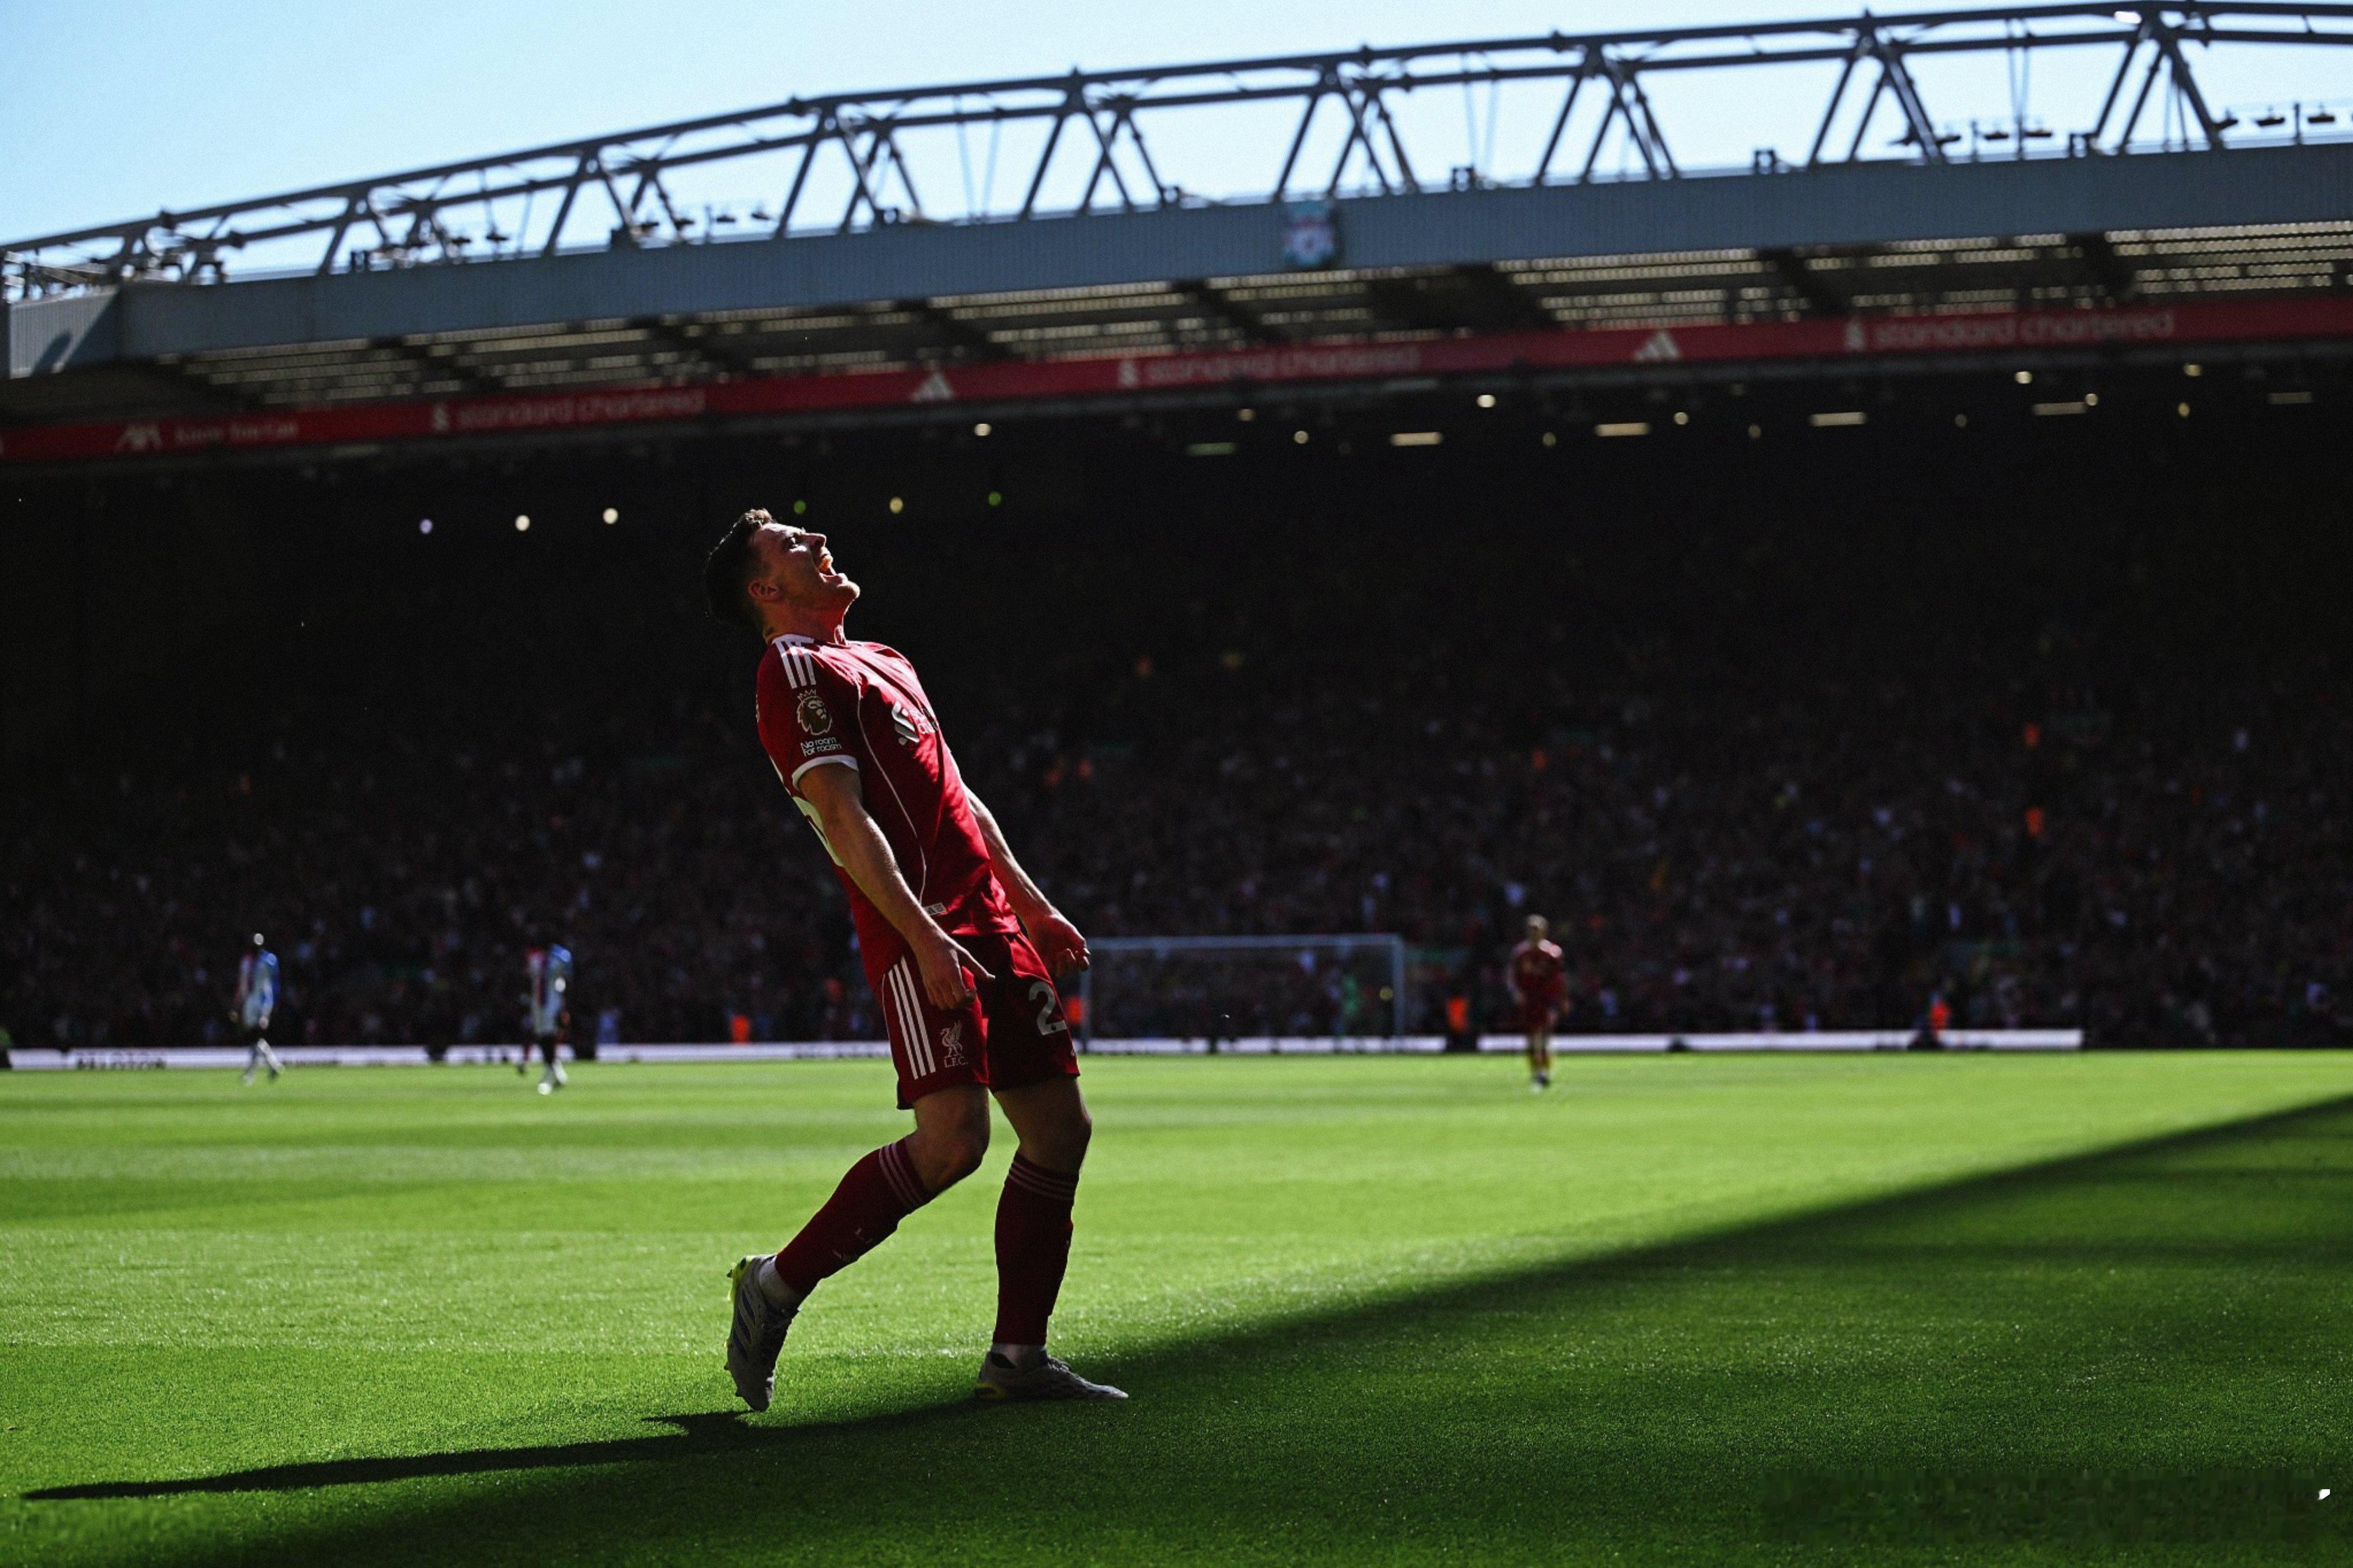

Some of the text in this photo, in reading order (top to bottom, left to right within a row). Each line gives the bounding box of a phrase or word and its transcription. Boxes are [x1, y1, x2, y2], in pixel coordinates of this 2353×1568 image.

[800, 737, 836, 748] No room
[803, 744, 842, 757] for racism
[1028, 981, 1067, 1036] 2
